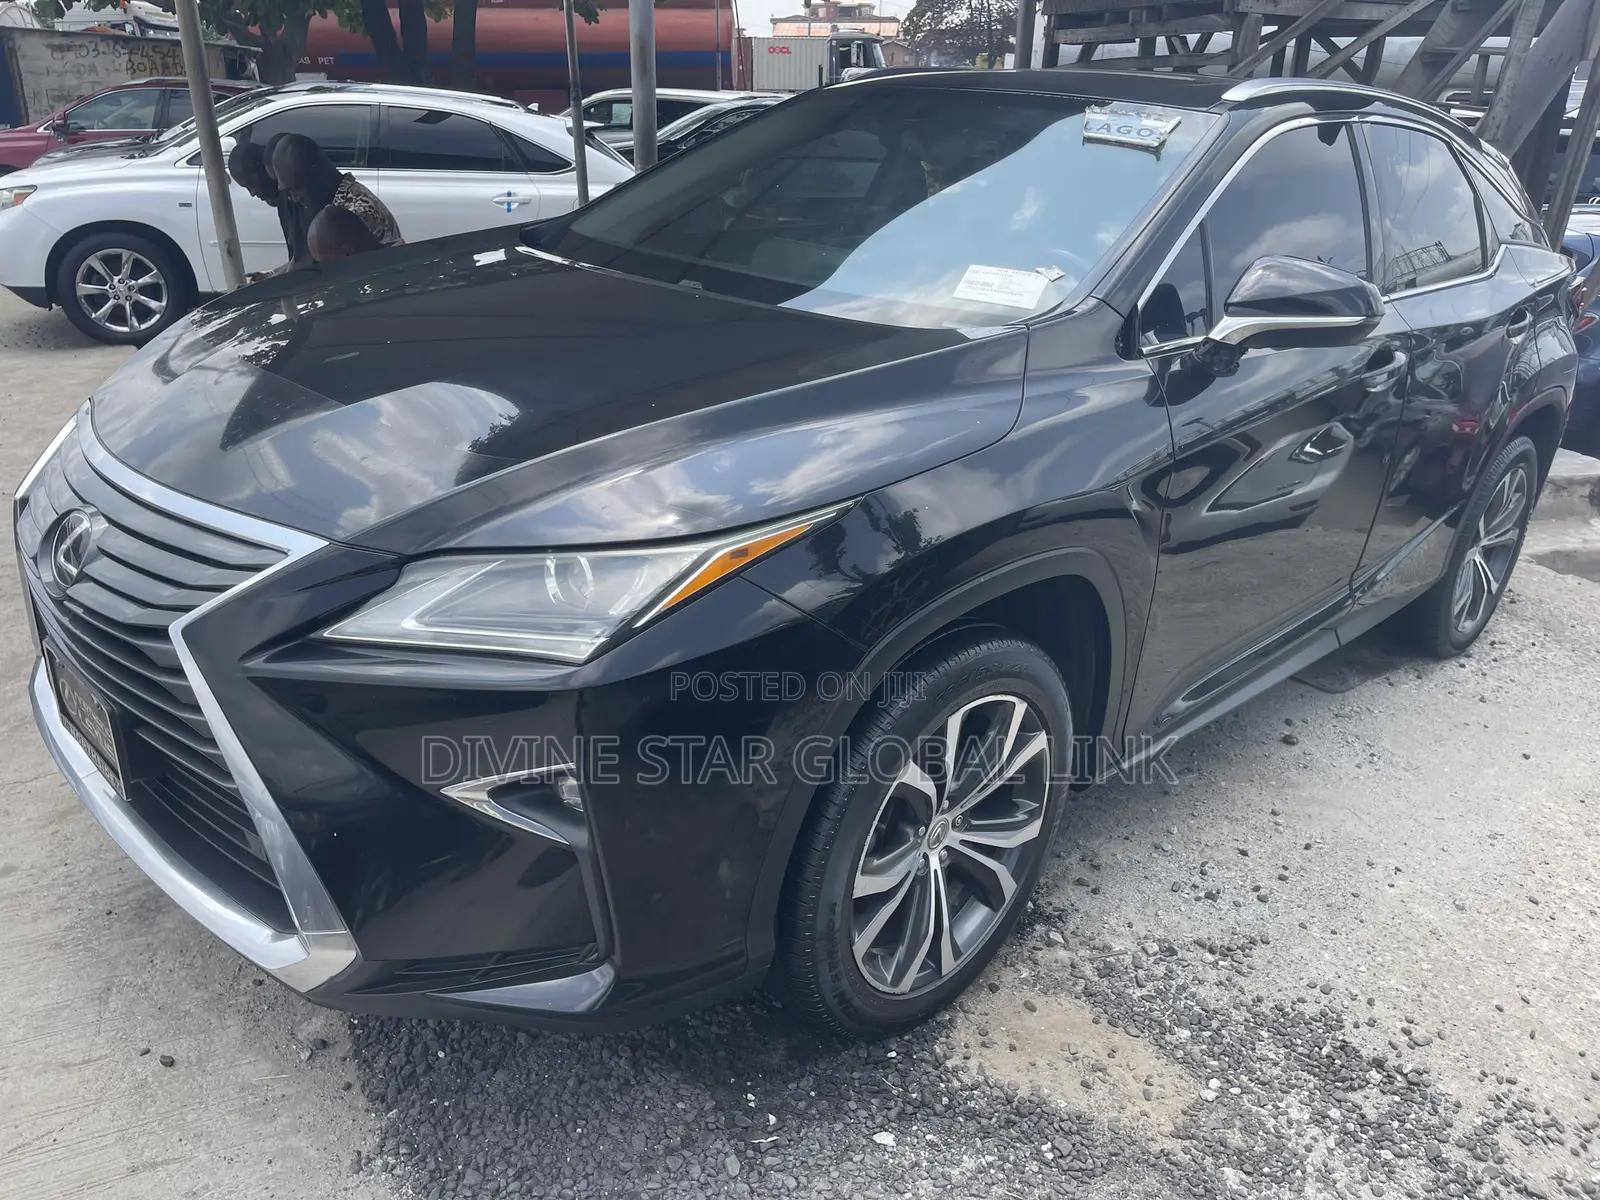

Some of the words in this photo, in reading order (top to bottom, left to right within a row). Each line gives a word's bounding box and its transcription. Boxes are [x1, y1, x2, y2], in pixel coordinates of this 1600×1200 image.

[768, 46, 792, 54] OOCL
[317, 56, 335, 65] PET
[1084, 121, 1161, 139] LAGO
